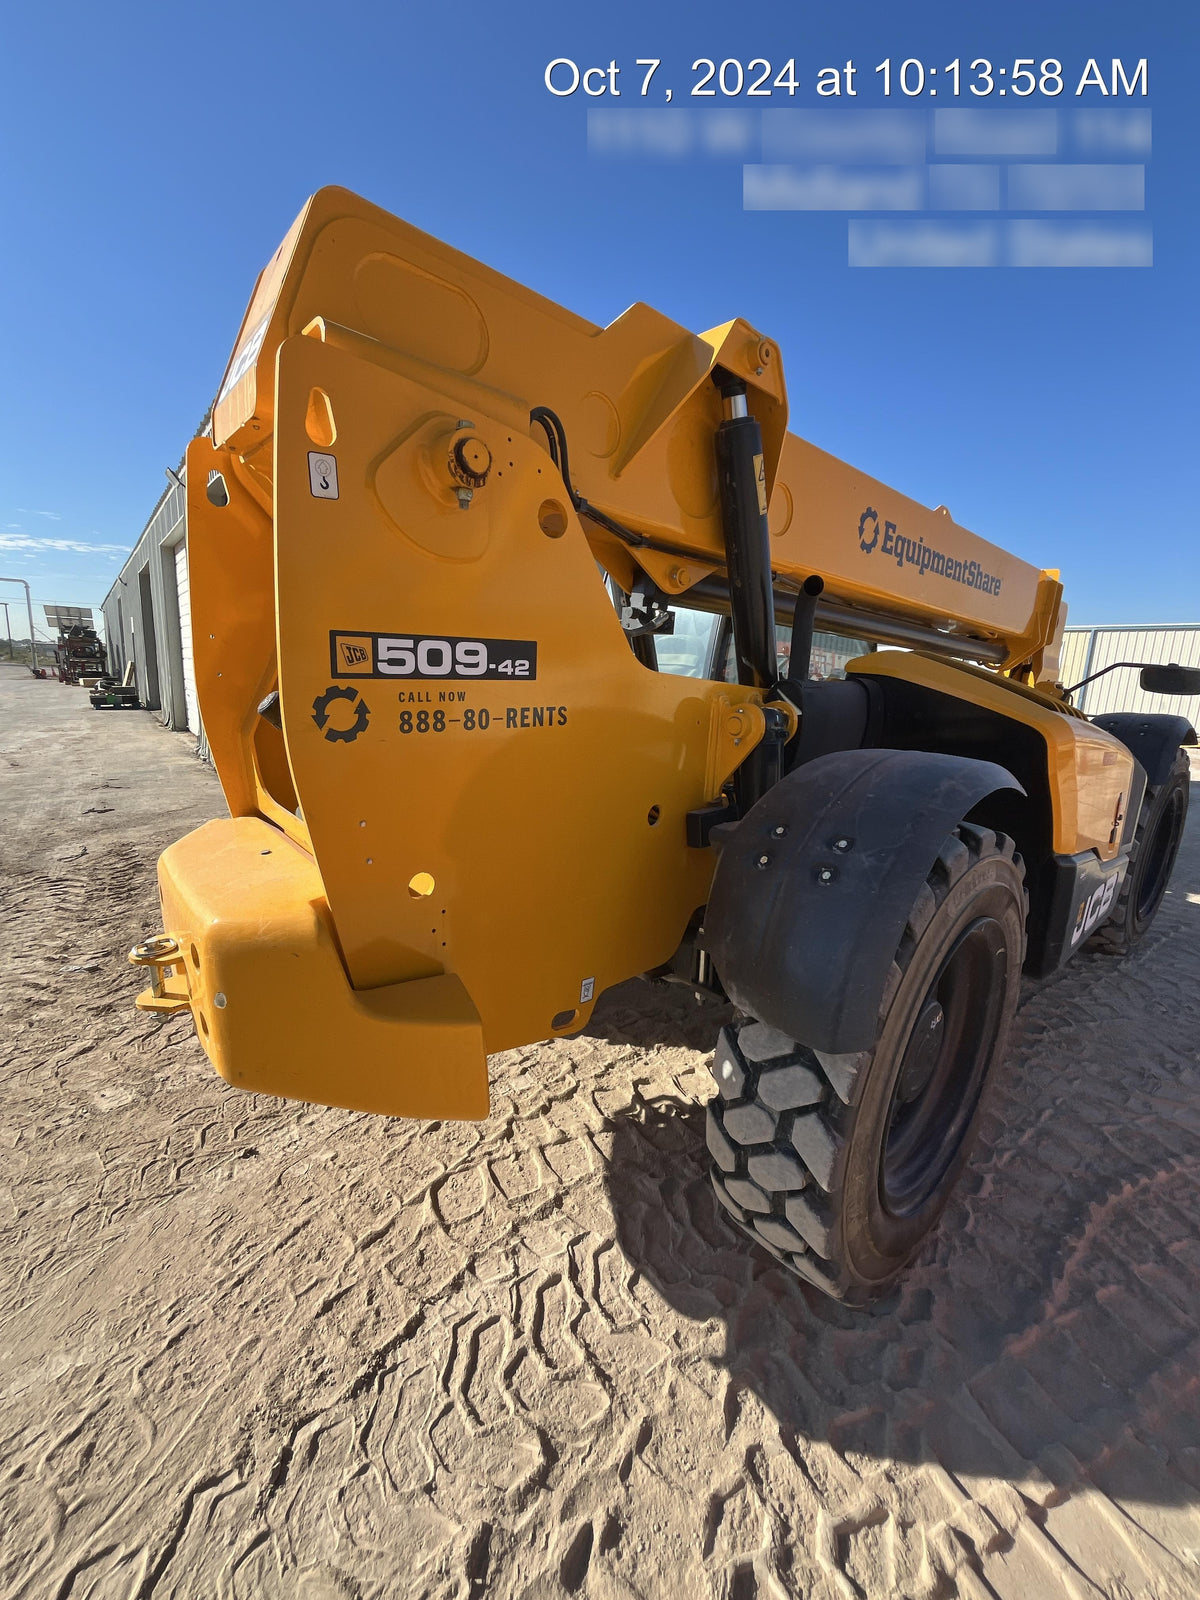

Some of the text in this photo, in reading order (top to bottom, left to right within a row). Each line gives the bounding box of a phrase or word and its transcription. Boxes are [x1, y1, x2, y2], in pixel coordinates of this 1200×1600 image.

[882, 521, 1001, 596] EquipmentShare
[343, 637, 530, 676] JCB 509-42
[398, 691, 466, 703] CALL NOW
[398, 705, 568, 734] 888-80-RENTS
[1071, 872, 1118, 947] JCB
